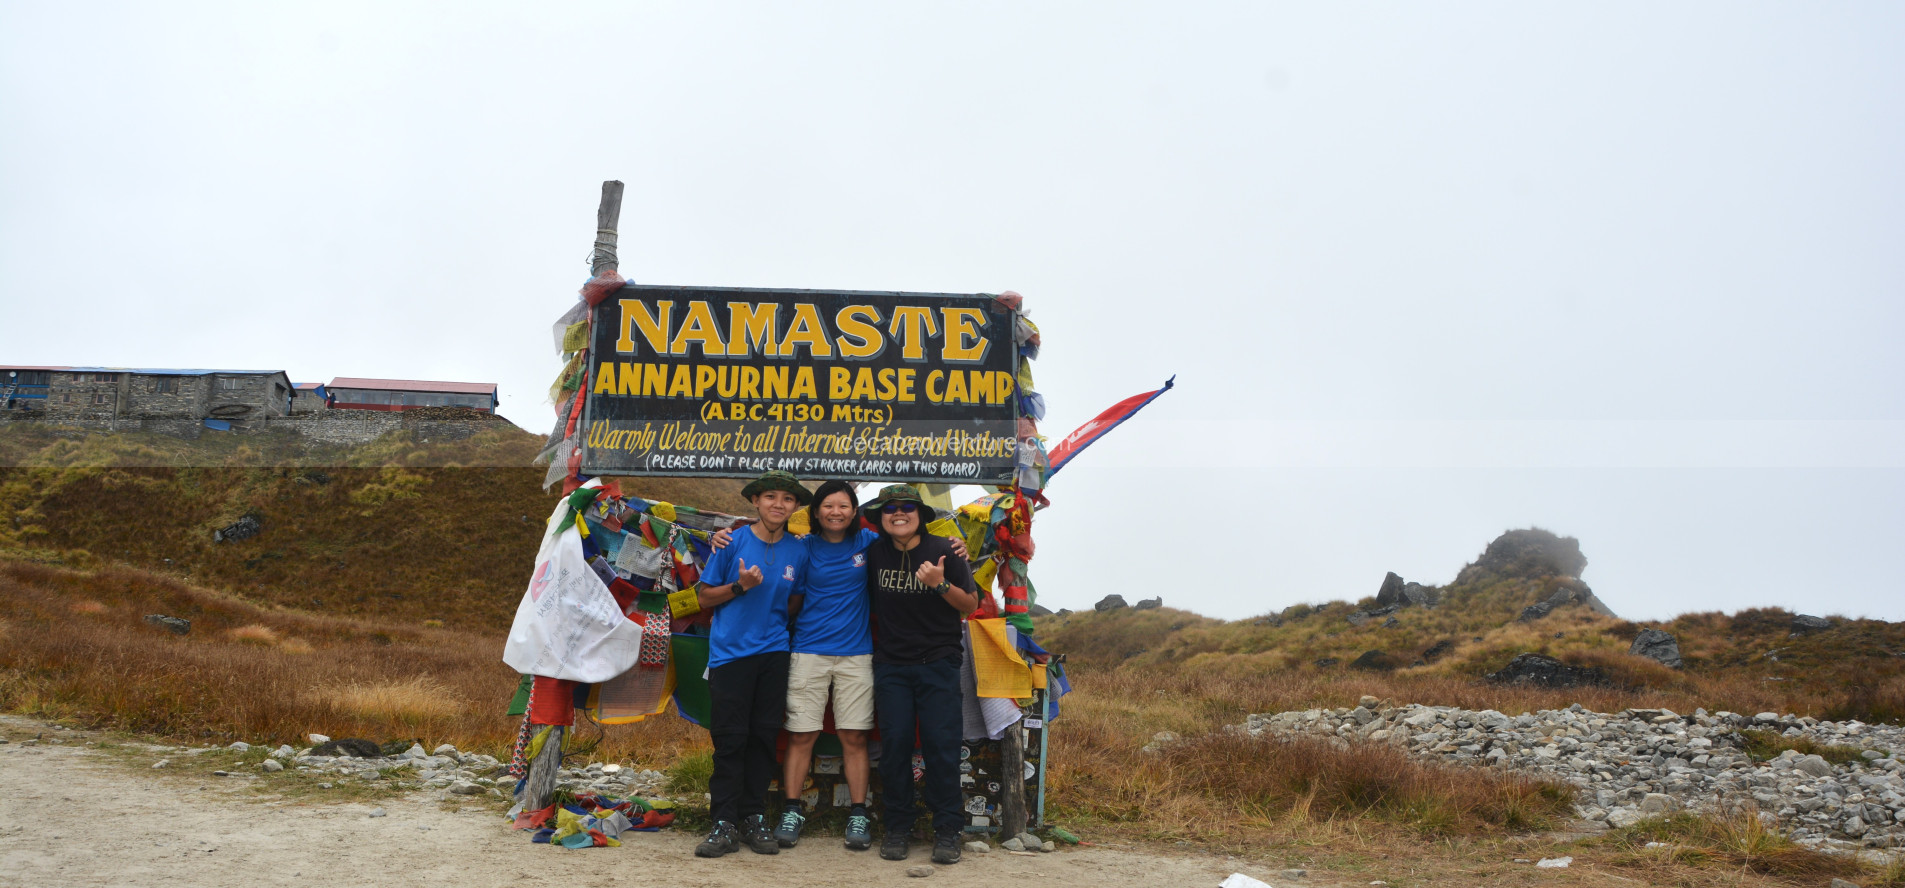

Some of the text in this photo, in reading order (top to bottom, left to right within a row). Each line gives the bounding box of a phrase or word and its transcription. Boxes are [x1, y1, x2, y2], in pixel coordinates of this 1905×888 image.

[616, 299, 991, 364] NAMASTE
[593, 362, 1014, 405] ANNAPURNA BASE CAMP
[831, 404, 893, 425] Mtrs)
[588, 418, 656, 458] Warmly
[660, 421, 731, 454] Welcome
[733, 424, 751, 452] to
[752, 425, 780, 453] all
[953, 429, 1015, 458] Visitors
[645, 452, 696, 471] (PLEASE
[700, 455, 735, 469] DON'T
[738, 456, 774, 471] PLACE
[777, 457, 803, 471] ANY
[895, 461, 910, 473] ON
[912, 461, 938, 474] THIS
[940, 461, 980, 478] BOARD)
